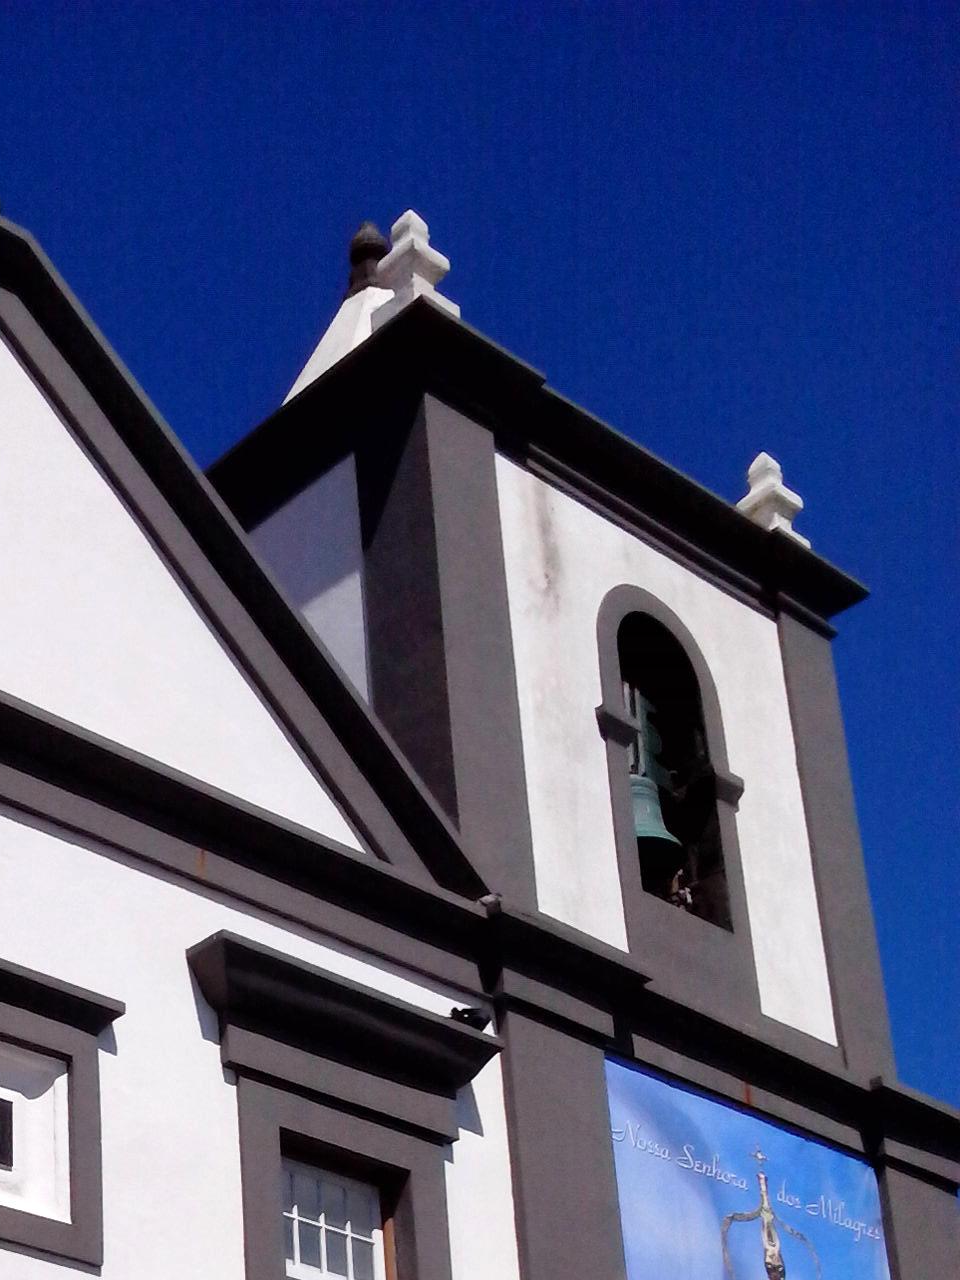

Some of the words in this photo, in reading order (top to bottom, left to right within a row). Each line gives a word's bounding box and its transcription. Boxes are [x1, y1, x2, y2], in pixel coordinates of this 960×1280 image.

[611, 1119, 672, 1162] Nossa
[677, 1143, 749, 1191] Senhora
[776, 1180, 802, 1209] dos
[806, 1194, 882, 1242] Milagres
